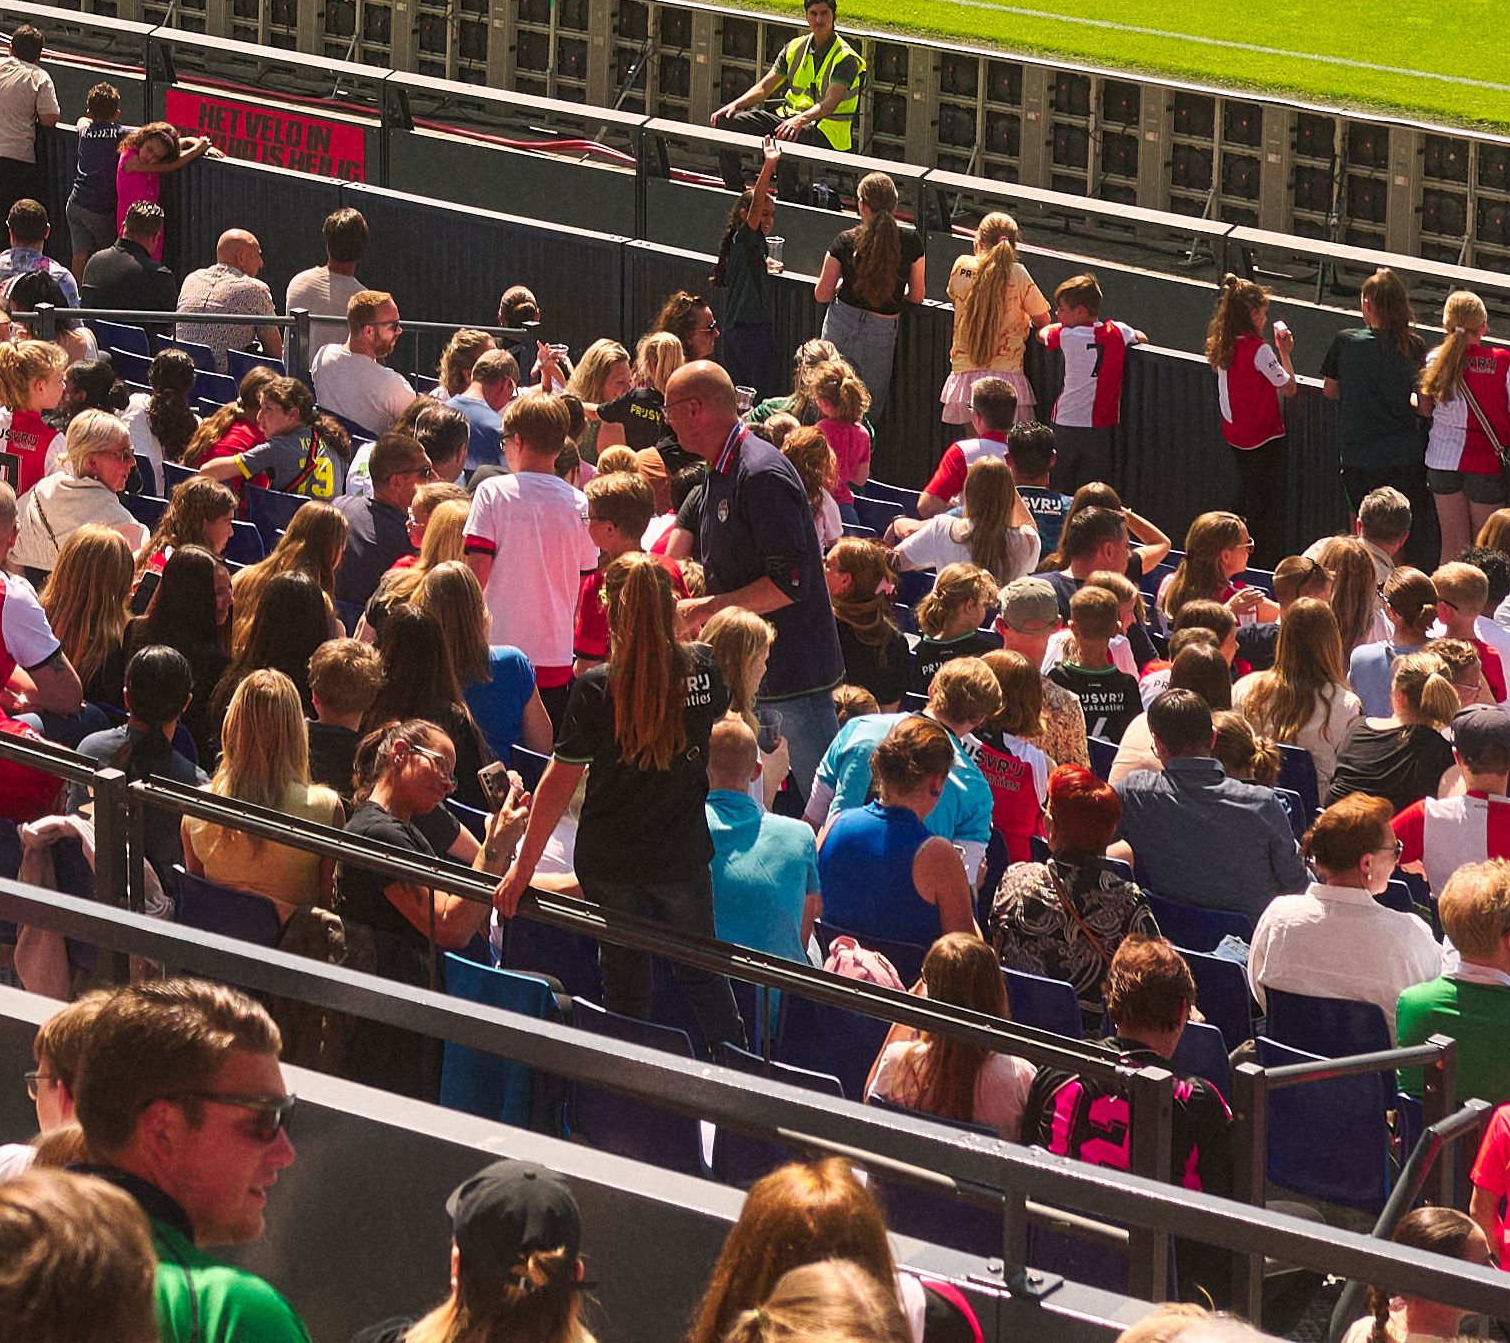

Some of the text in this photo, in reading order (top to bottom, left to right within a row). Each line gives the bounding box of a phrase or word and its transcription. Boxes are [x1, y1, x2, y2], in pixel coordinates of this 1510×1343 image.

[198, 101, 241, 133] HET
[244, 111, 303, 150] VELD
[306, 125, 332, 155] IN
[1086, 342, 1104, 378] 7
